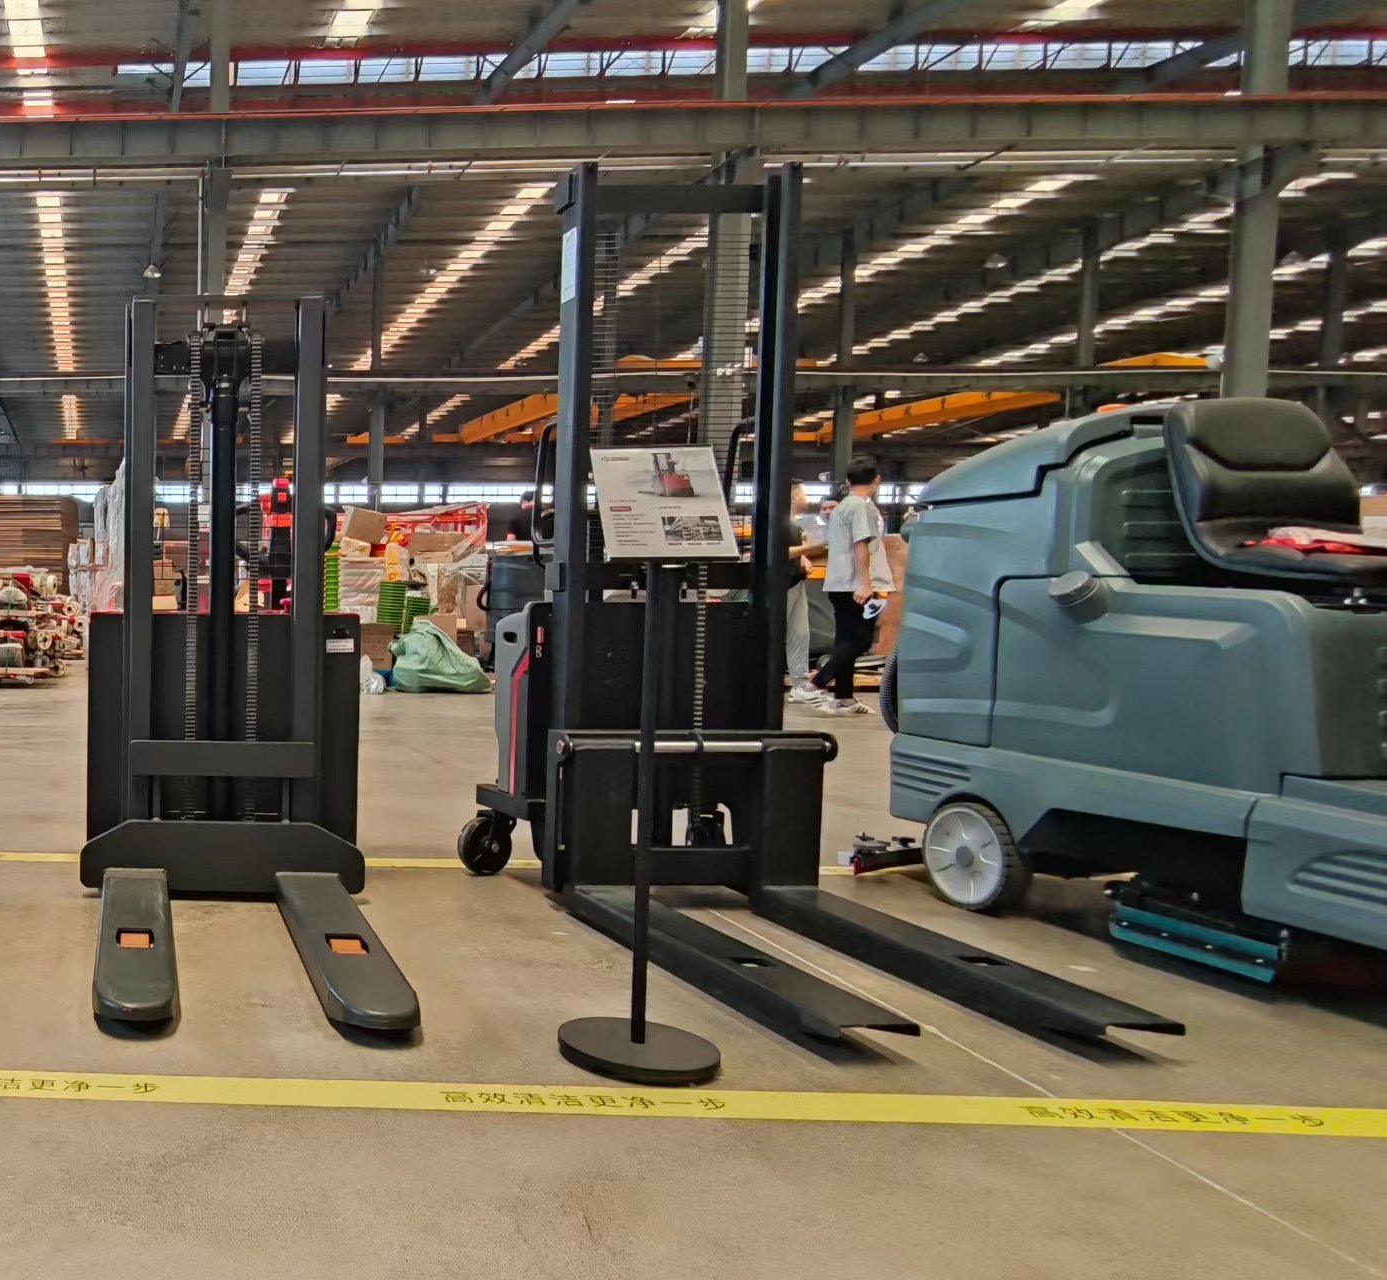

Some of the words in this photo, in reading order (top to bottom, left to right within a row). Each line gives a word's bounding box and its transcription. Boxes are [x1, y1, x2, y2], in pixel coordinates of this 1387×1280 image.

[441, 1091, 726, 1111] 高效清洁更净一步
[1019, 1105, 1324, 1127] 高效清洁更净一步
